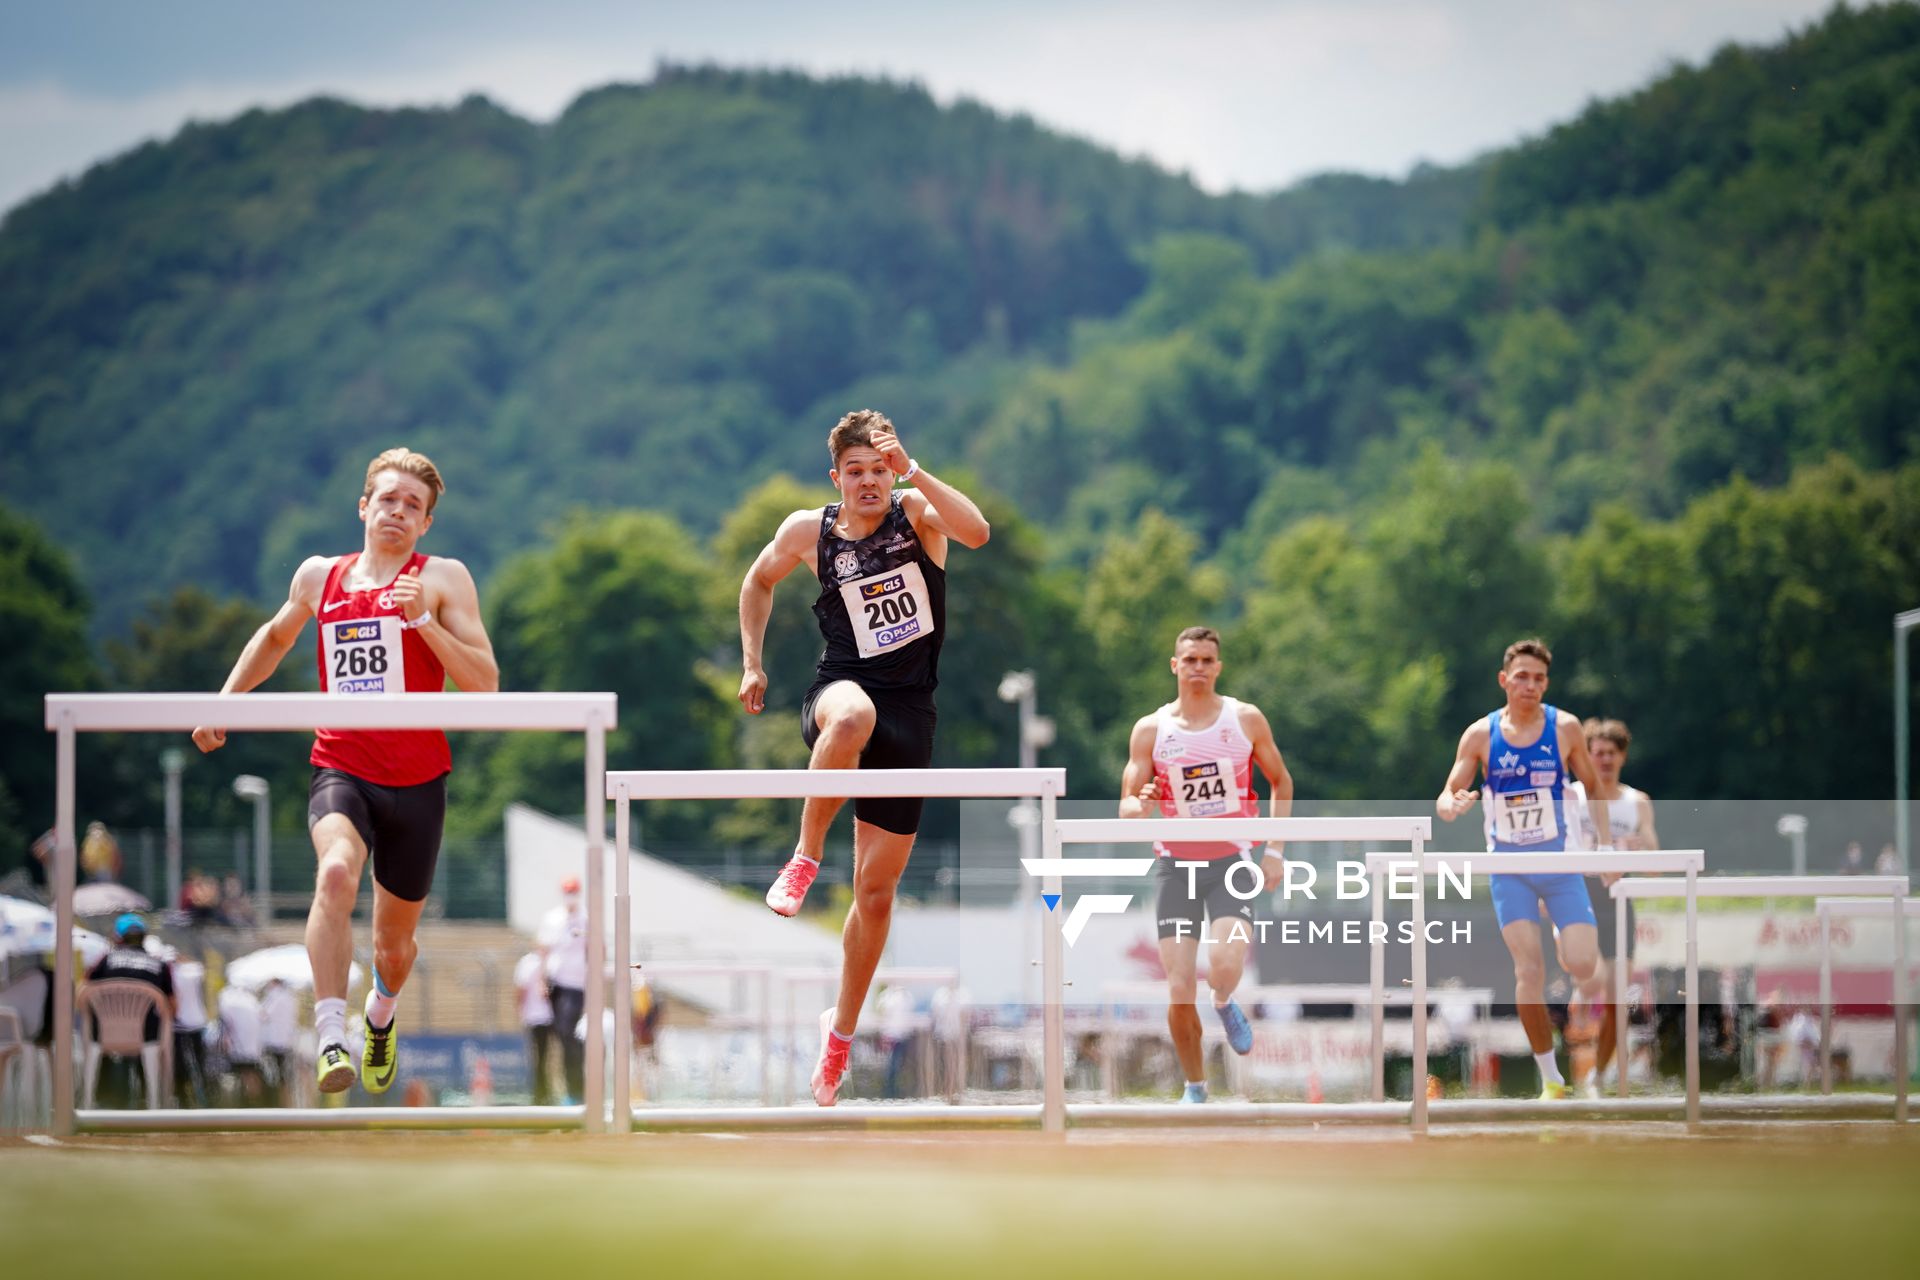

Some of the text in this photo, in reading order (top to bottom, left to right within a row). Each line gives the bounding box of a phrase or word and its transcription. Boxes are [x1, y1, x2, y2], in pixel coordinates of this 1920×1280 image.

[834, 551, 859, 577] 96
[884, 579, 901, 592] GLS
[864, 592, 917, 630] 200
[358, 626, 377, 639] GLS
[893, 622, 917, 636] PLAN
[334, 645, 388, 678] 268
[354, 680, 382, 692] PLAN
[1182, 779, 1226, 802] 244
[1506, 808, 1543, 829] 177
